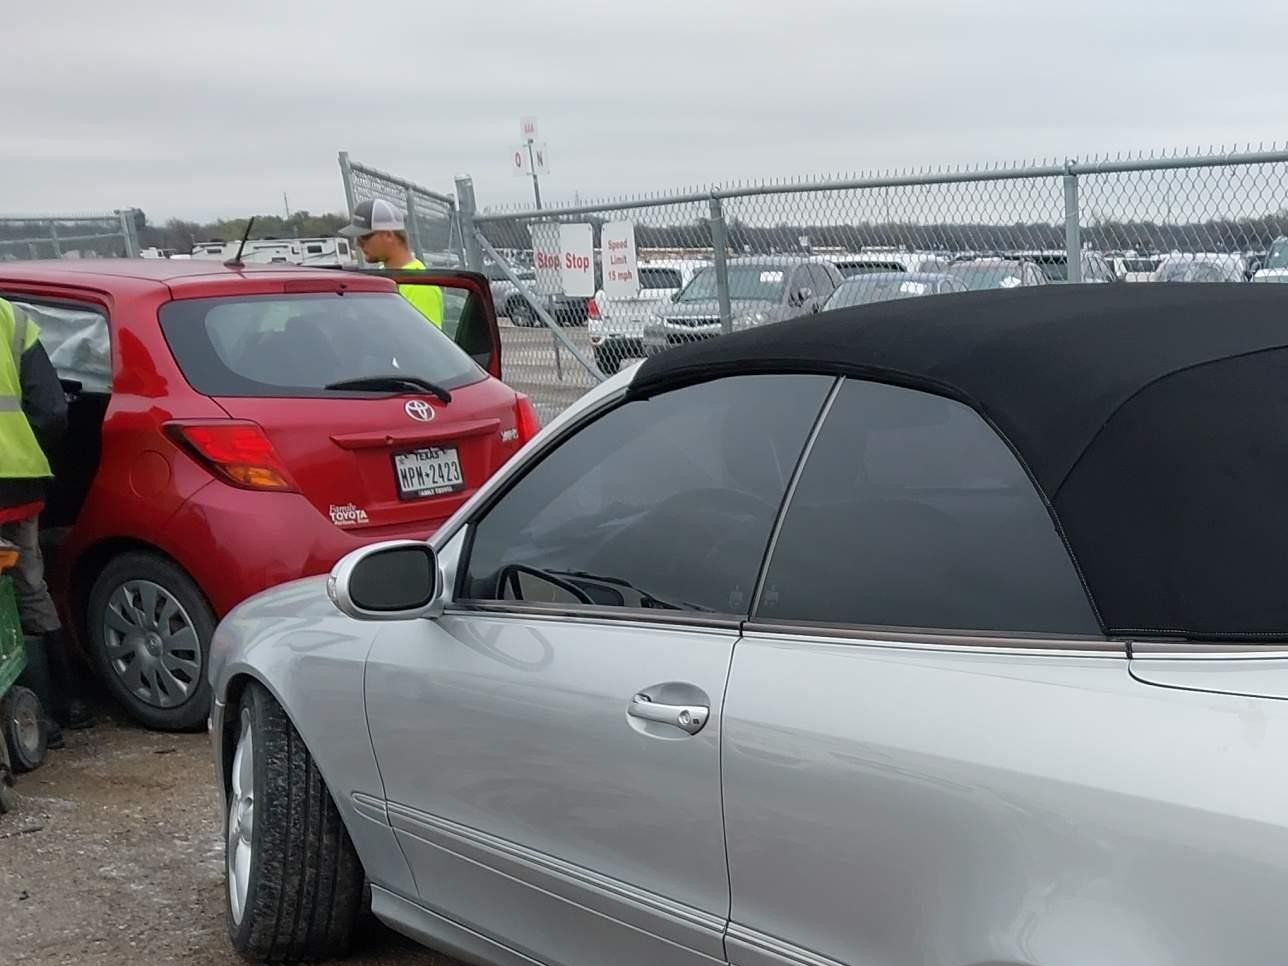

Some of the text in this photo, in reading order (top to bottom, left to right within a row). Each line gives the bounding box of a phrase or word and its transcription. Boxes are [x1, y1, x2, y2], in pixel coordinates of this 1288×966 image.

[536, 151, 543, 167] N
[608, 239, 628, 251] Speed
[537, 252, 560, 271] Stop
[565, 252, 590, 273] Stop
[610, 255, 627, 265] Limit
[608, 269, 633, 282] 15 mph
[416, 451, 440, 462] TEXAS
[330, 510, 368, 521] TOYOTA
